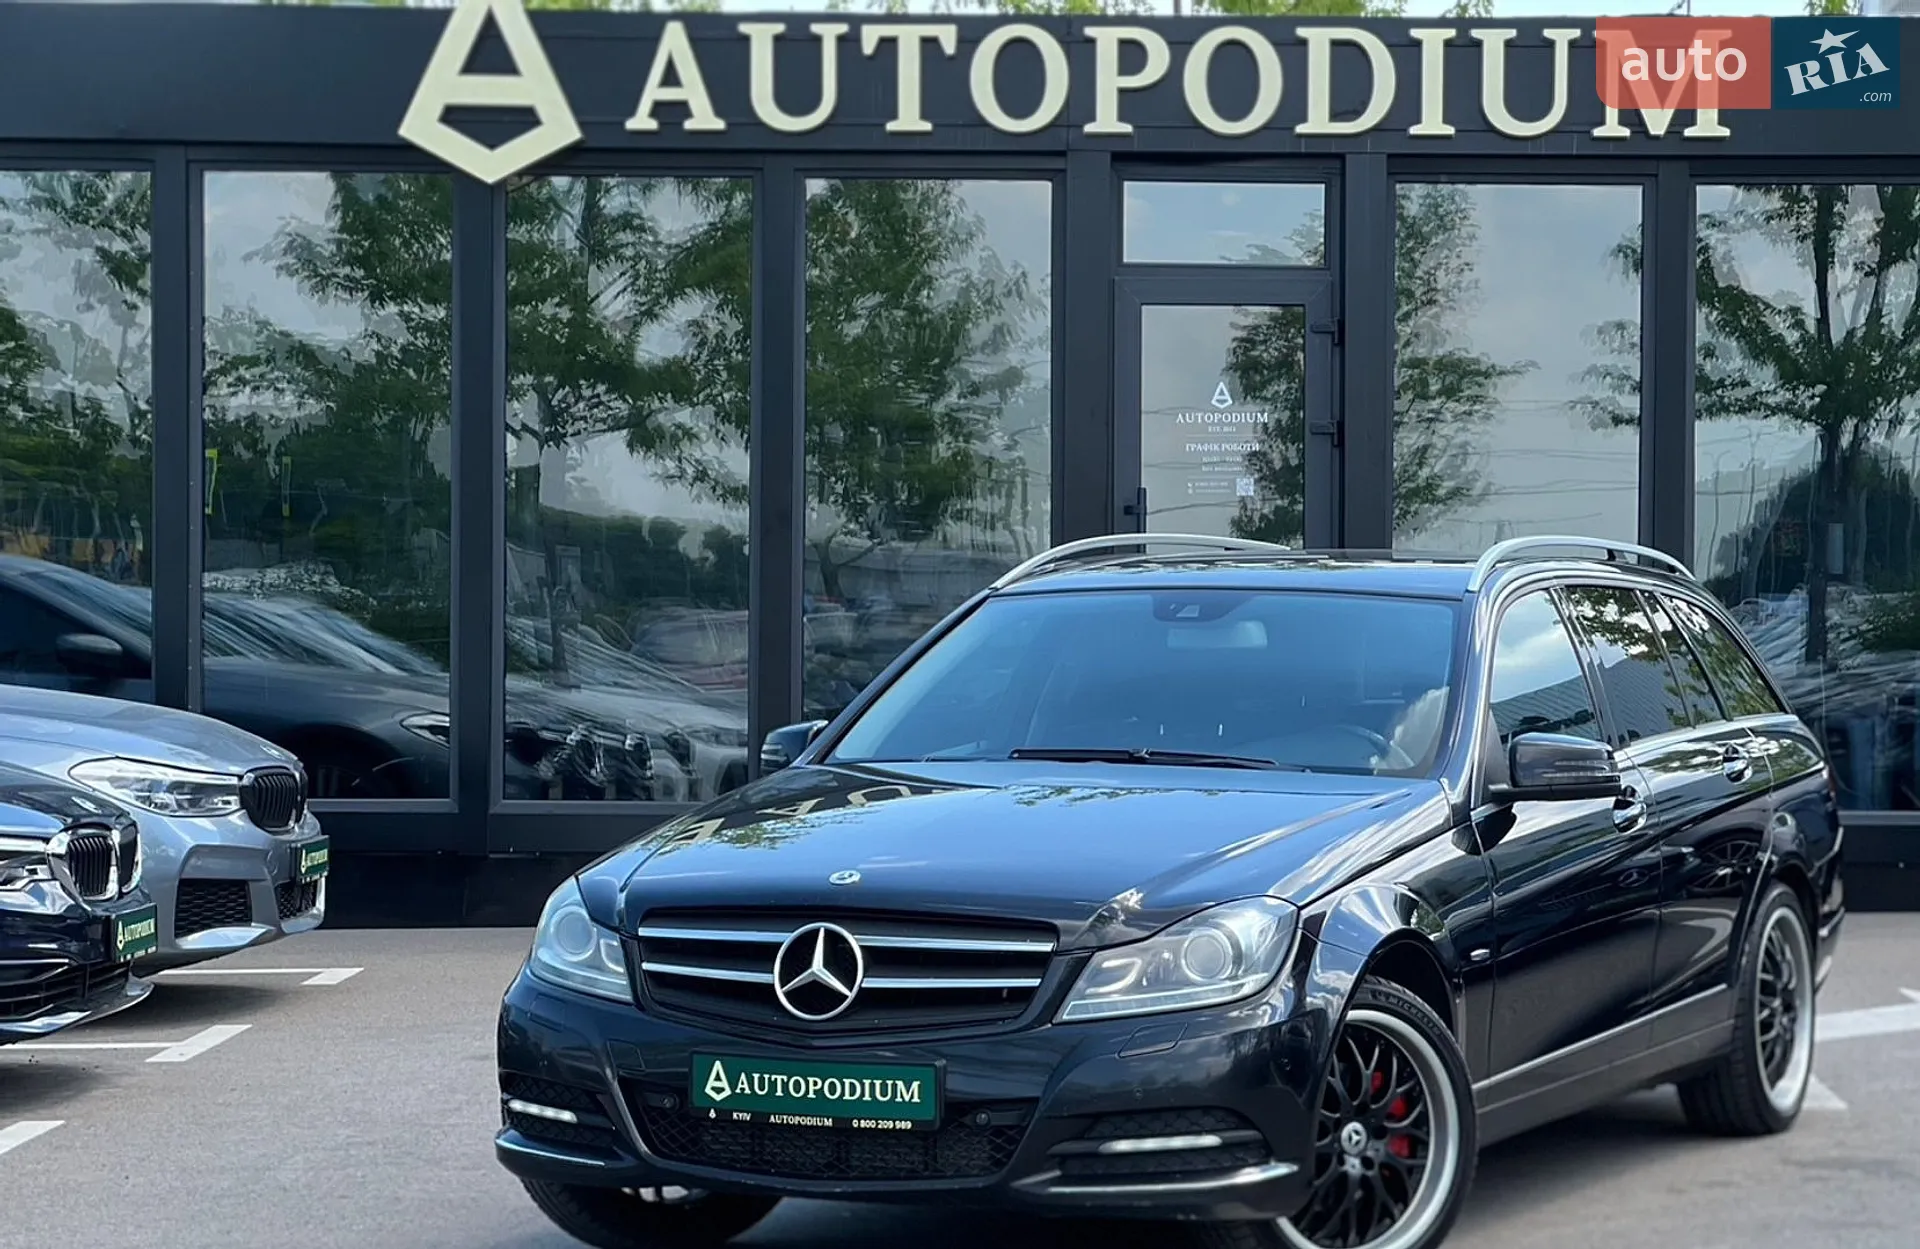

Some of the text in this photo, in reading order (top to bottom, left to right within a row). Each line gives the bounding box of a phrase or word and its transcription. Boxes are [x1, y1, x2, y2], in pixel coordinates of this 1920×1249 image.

[624, 20, 1732, 138] AUTOPODIUM
[1176, 411, 1268, 424] AUTOPODIUM
[1185, 443, 1220, 452] ГРАФІК
[735, 1072, 921, 1103] AUTOPODIUM
[732, 1111, 752, 1122] KYIV
[768, 1114, 834, 1127] AUTOPODIUM
